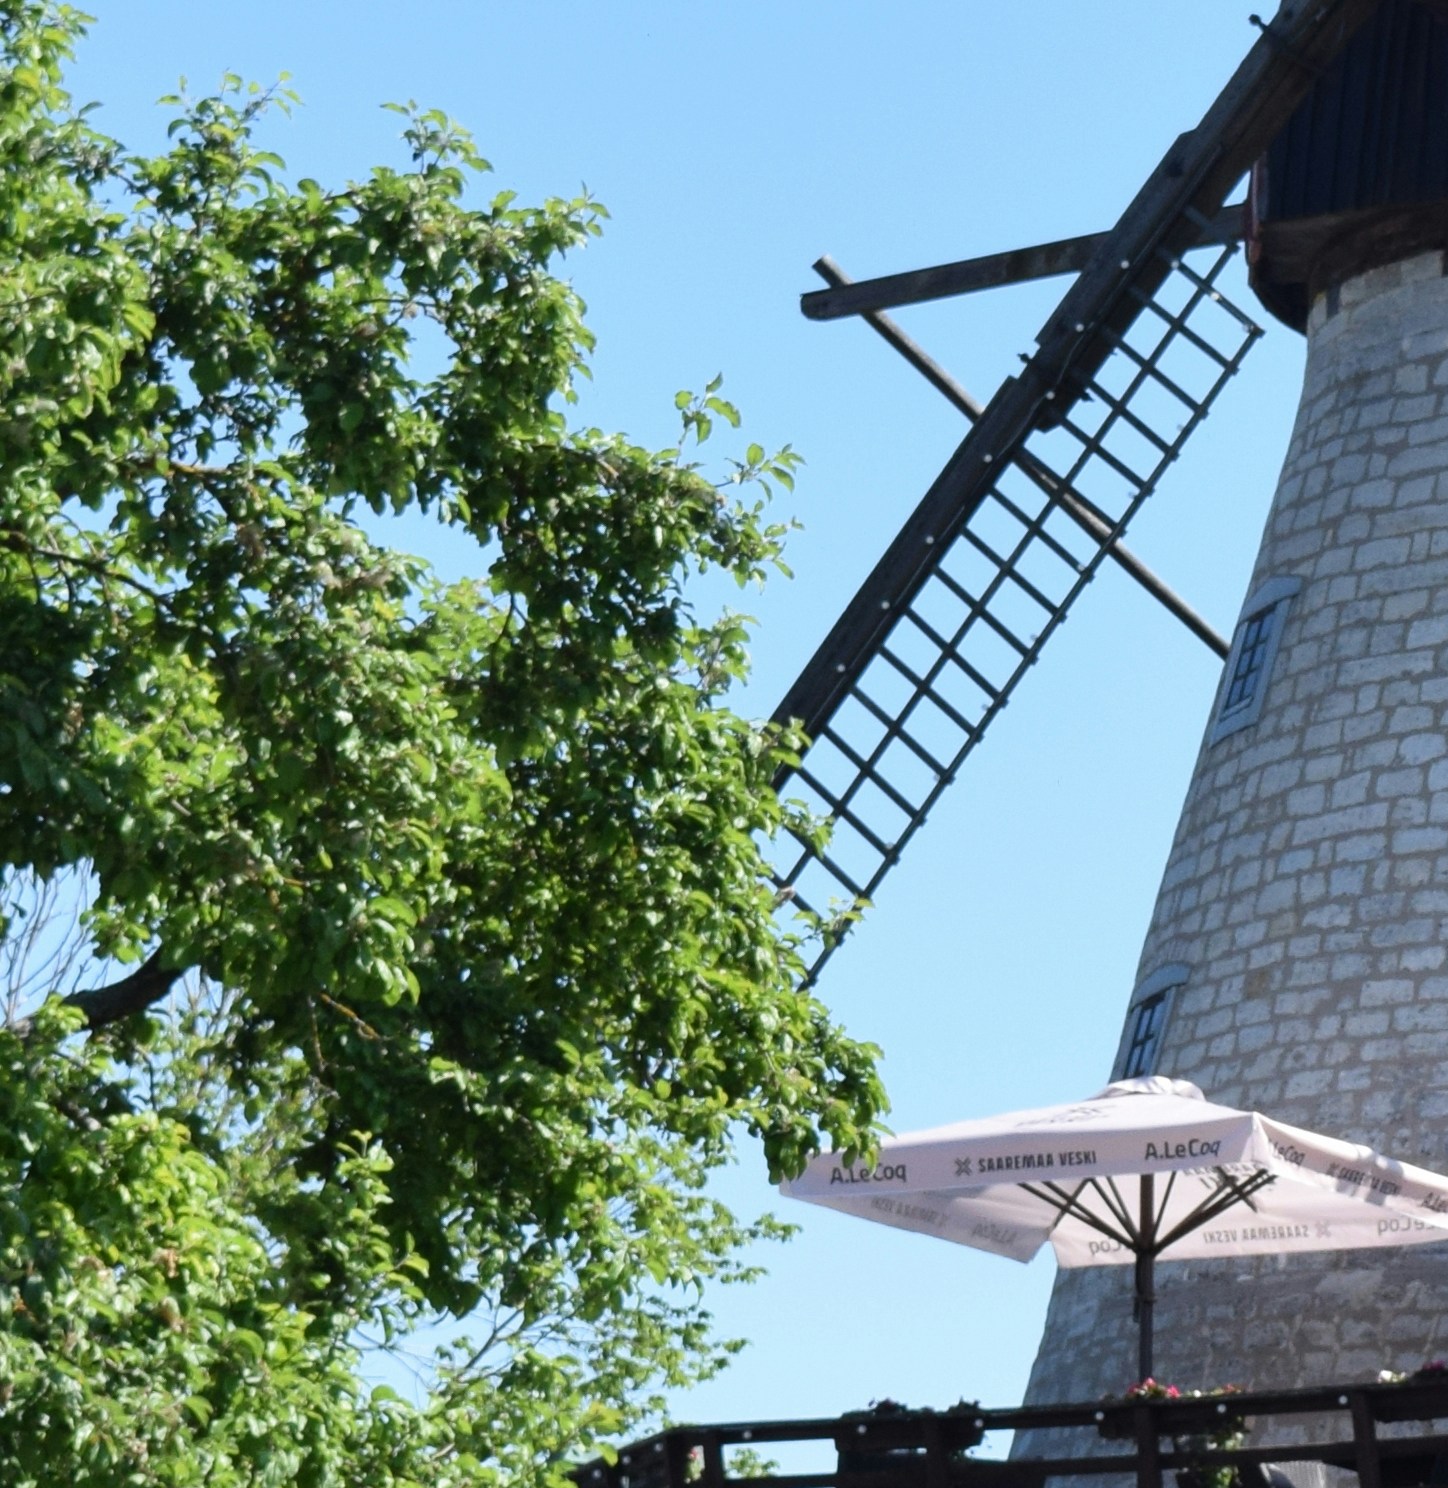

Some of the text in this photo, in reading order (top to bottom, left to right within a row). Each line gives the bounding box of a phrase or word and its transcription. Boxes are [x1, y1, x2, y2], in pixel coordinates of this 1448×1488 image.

[977, 1149, 1097, 1173] SAAREMAA VESKI
[1144, 1138, 1222, 1161] A.LeCoq
[829, 1164, 907, 1185] A.LeCoq
